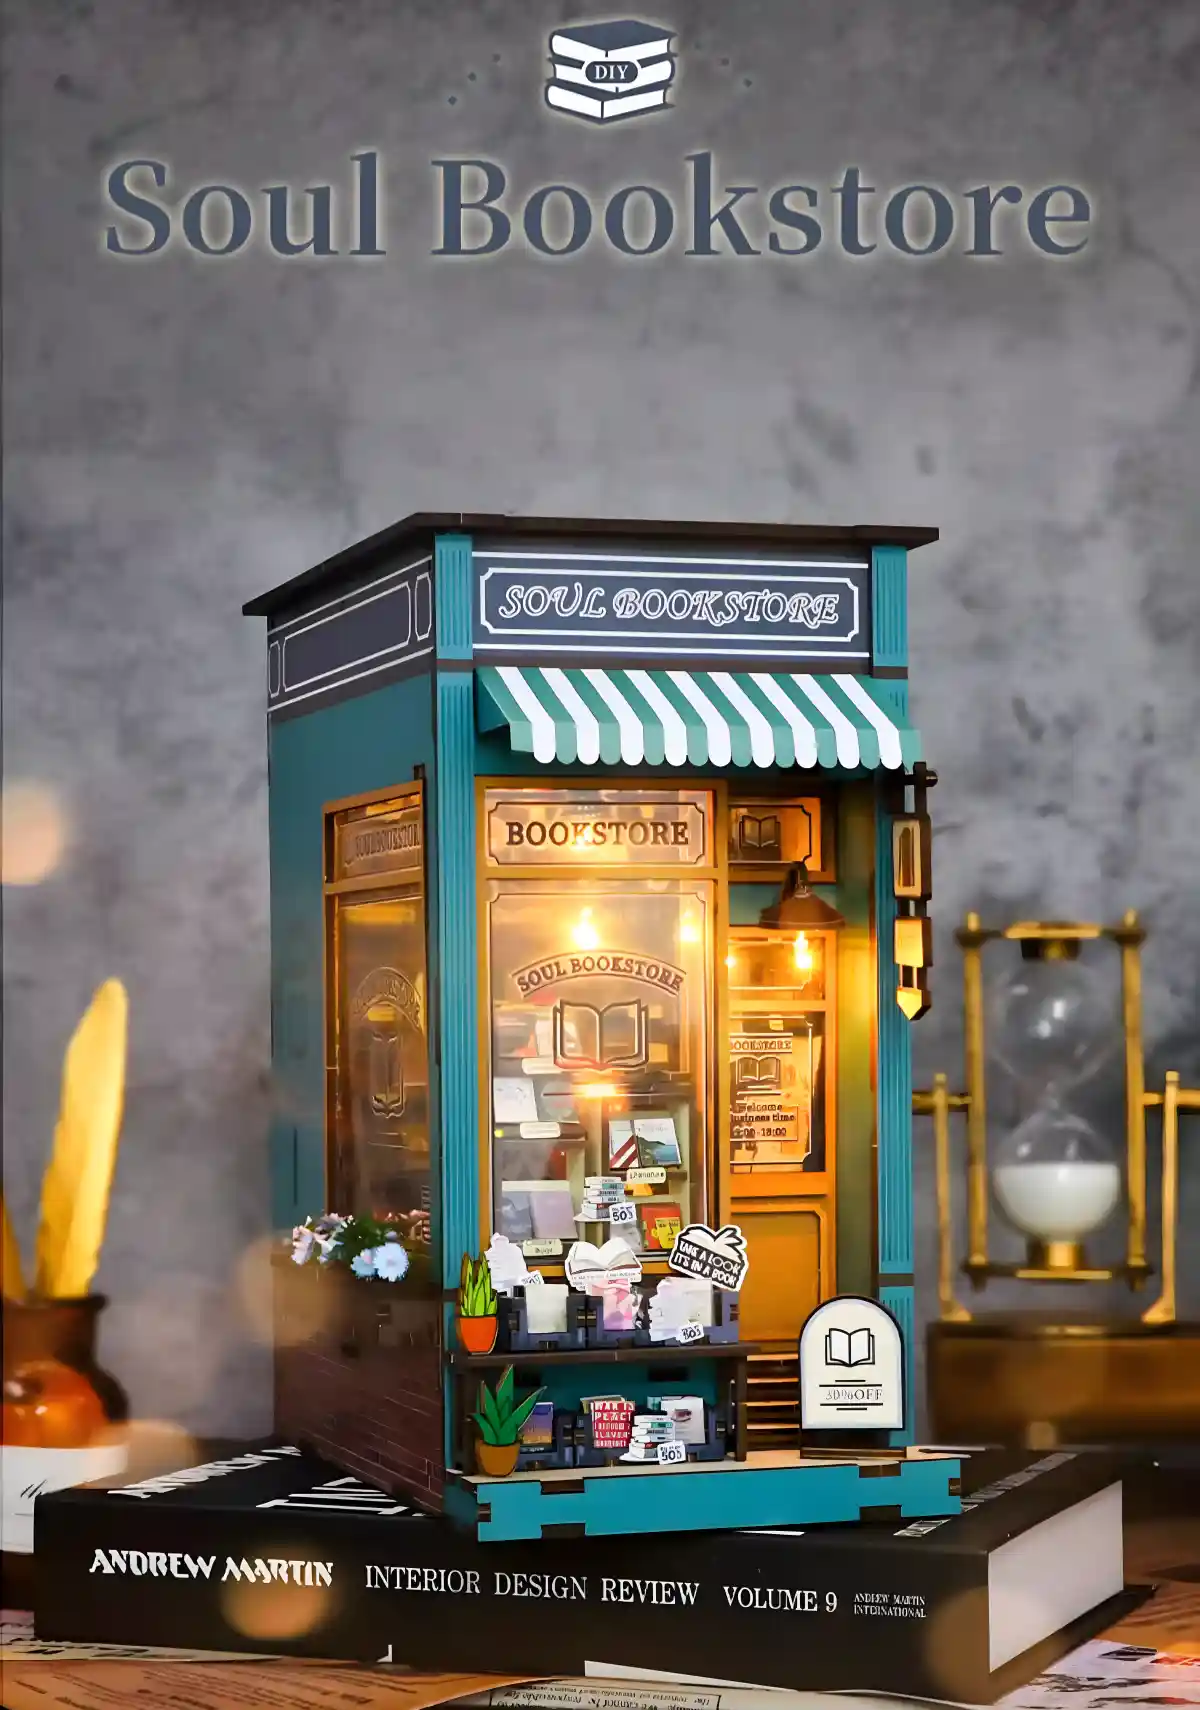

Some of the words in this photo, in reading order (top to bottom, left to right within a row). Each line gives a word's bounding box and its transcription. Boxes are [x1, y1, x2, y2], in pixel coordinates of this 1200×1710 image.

[498, 581, 607, 619] SOUL
[612, 588, 841, 629] BOOKSTORE
[505, 821, 689, 846] BOOKSTORE
[517, 960, 567, 992] SOUL
[570, 956, 684, 991] BOOKSTORE
[699, 1250, 707, 1261] A
[707, 1253, 741, 1275] LOOK
[703, 1265, 711, 1276] A
[711, 1268, 737, 1287] BOOK
[88, 1548, 217, 1579] ANDREW
[220, 1556, 334, 1588] MARTIN
[365, 1565, 482, 1594] INTERIOR
[493, 1572, 588, 1600] DESIGN
[600, 1577, 701, 1605] REVIEW
[723, 1586, 818, 1612] VOLUME
[824, 1591, 839, 1613] 9
[853, 1593, 891, 1604] ANDREW
[853, 1603, 927, 1618] INTERNATIONAL
